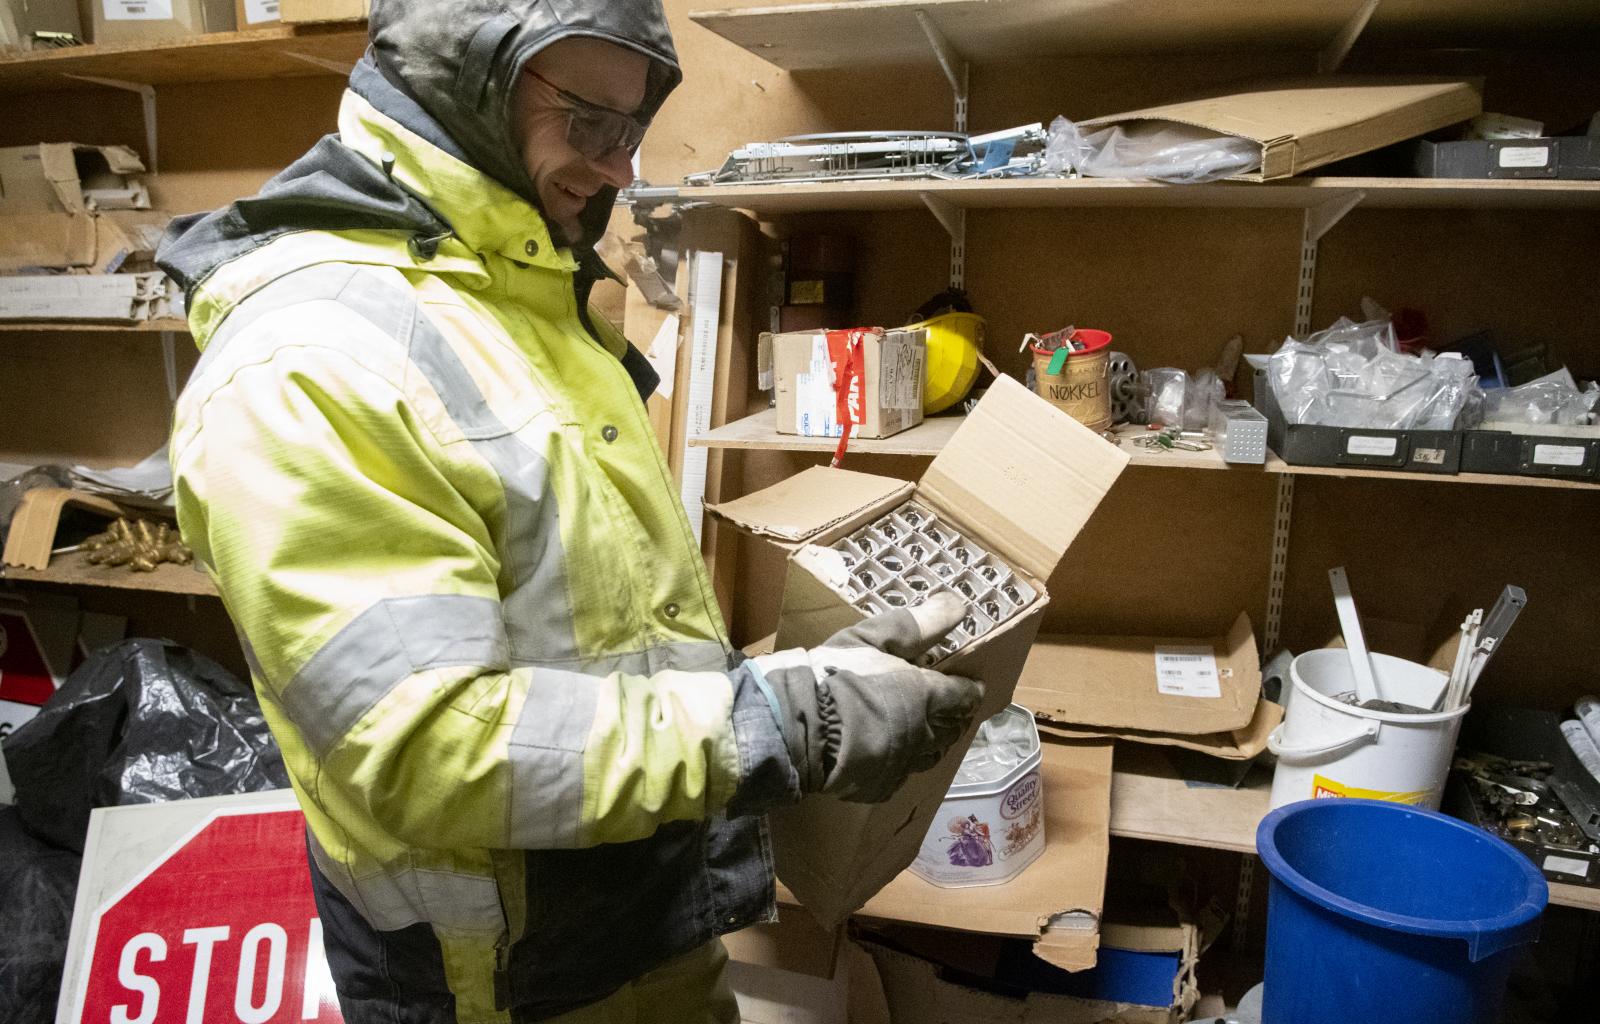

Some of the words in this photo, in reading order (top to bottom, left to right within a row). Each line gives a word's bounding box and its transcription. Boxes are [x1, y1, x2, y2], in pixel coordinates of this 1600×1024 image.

[1049, 381, 1101, 401] NØKKEL
[1006, 778, 1037, 806] Quality
[1010, 790, 1036, 815] Street
